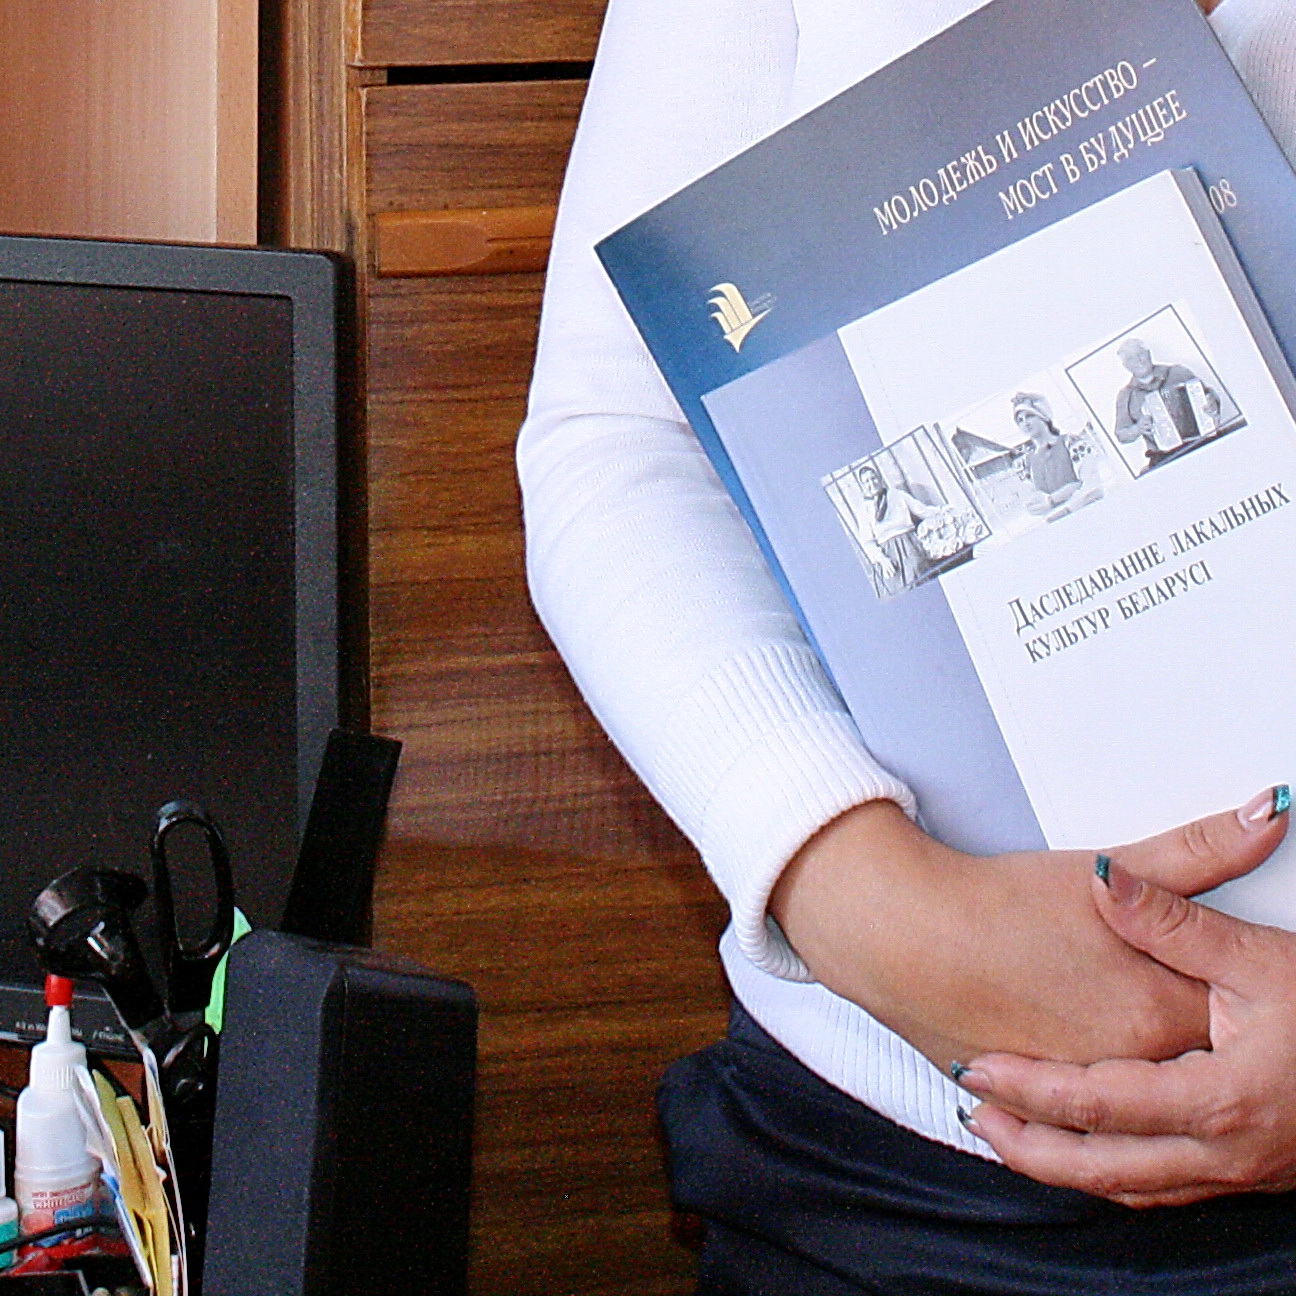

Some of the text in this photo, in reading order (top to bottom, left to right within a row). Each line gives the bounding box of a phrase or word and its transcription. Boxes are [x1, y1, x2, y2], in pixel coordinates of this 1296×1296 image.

[872, 59, 1139, 236] МОЛОДЕЖЬ И ИСКУССТВО
[998, 88, 1189, 219] МОСТ В БУДУЩЕЕ
[1172, 483, 1291, 557] ЛАКАЛЬНЫХ
[1024, 559, 1214, 664] КУЛЬТУР БЕЛАРУСІ
